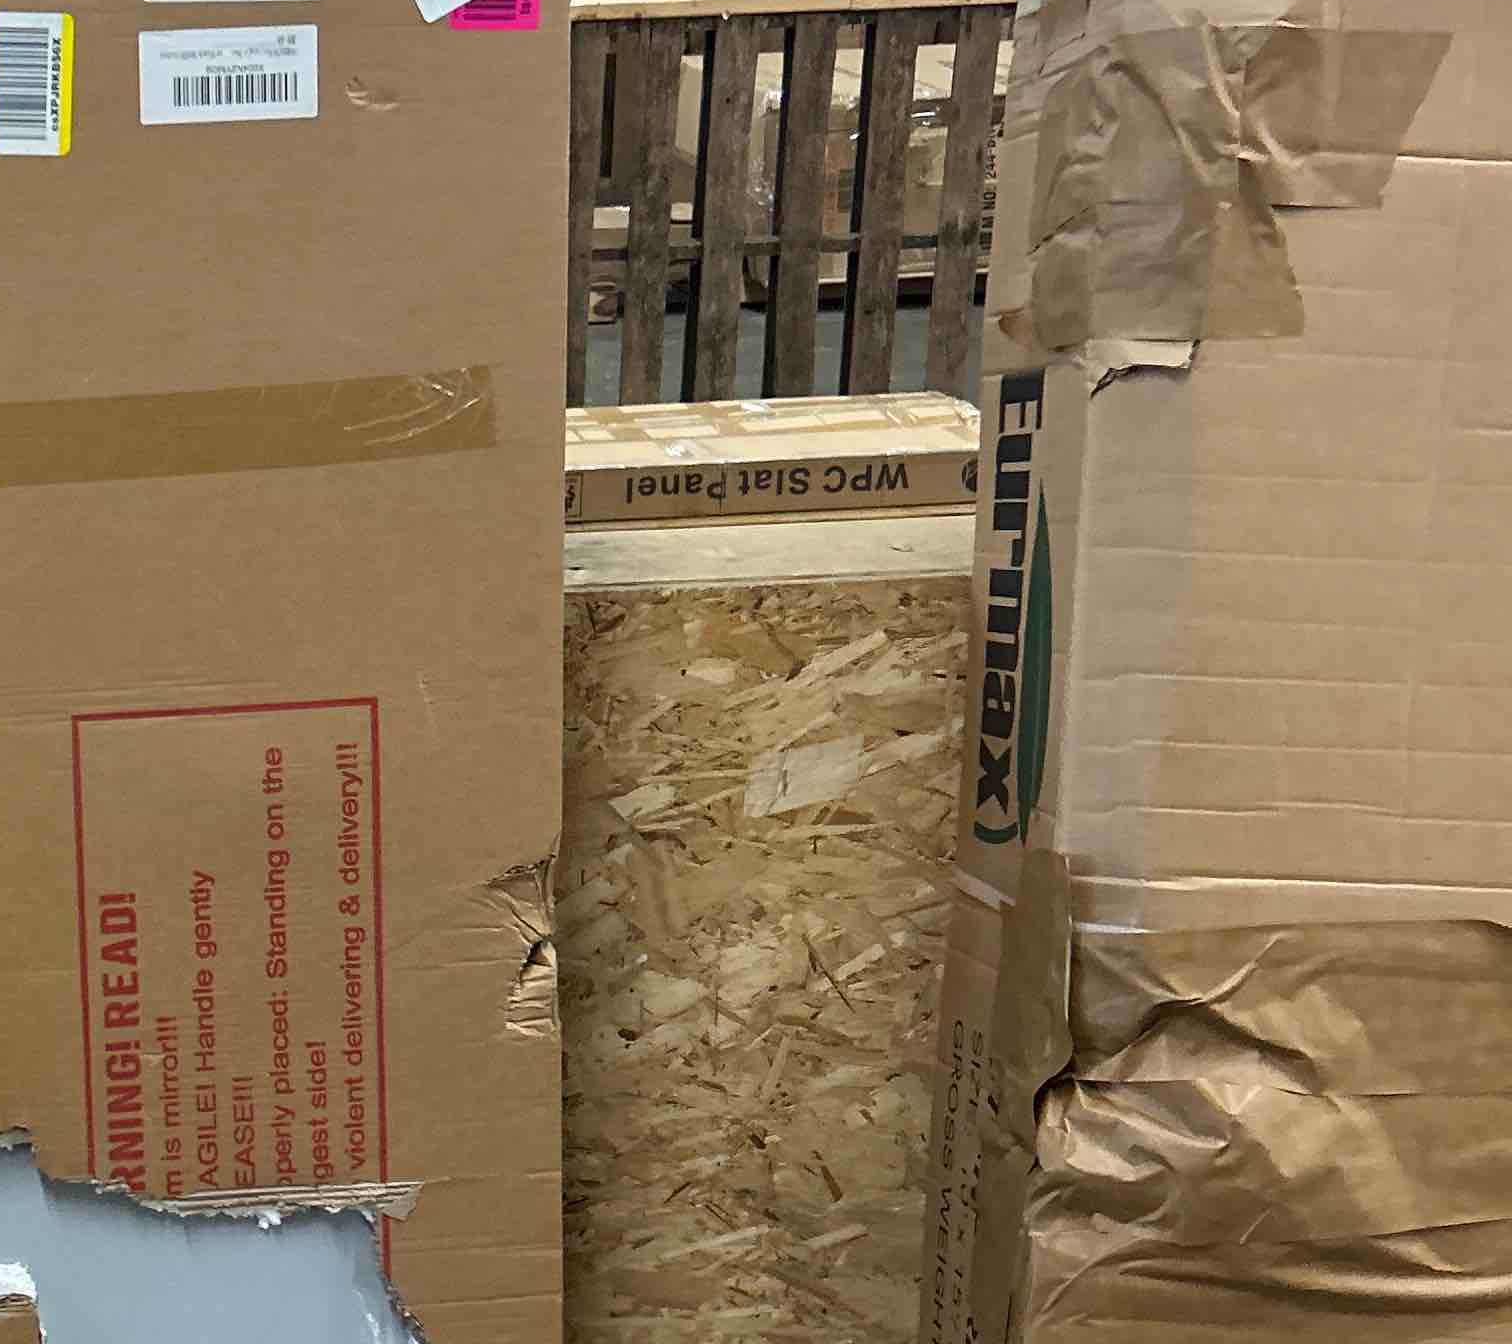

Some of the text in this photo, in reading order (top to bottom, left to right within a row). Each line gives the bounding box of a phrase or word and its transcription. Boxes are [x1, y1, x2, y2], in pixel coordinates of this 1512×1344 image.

[625, 462, 910, 505] WPC Slat Panel
[976, 367, 1046, 811] Eurmax
[261, 746, 284, 795] the
[265, 801, 285, 841] on
[263, 849, 290, 980] Standing
[336, 742, 367, 1169] violent delivering & delivery!!!
[98, 891, 145, 1196] RNING! READ!
[156, 1015, 181, 1130] mirror!!!
[191, 869, 219, 1187] AGILE! Handle gently
[266, 987, 292, 1095] placed:
[162, 1137, 182, 1166] is
[232, 1074, 256, 1187] EASE!!!
[305, 1039, 337, 1188] gest side!
[943, 1018, 965, 1172] GROSS
